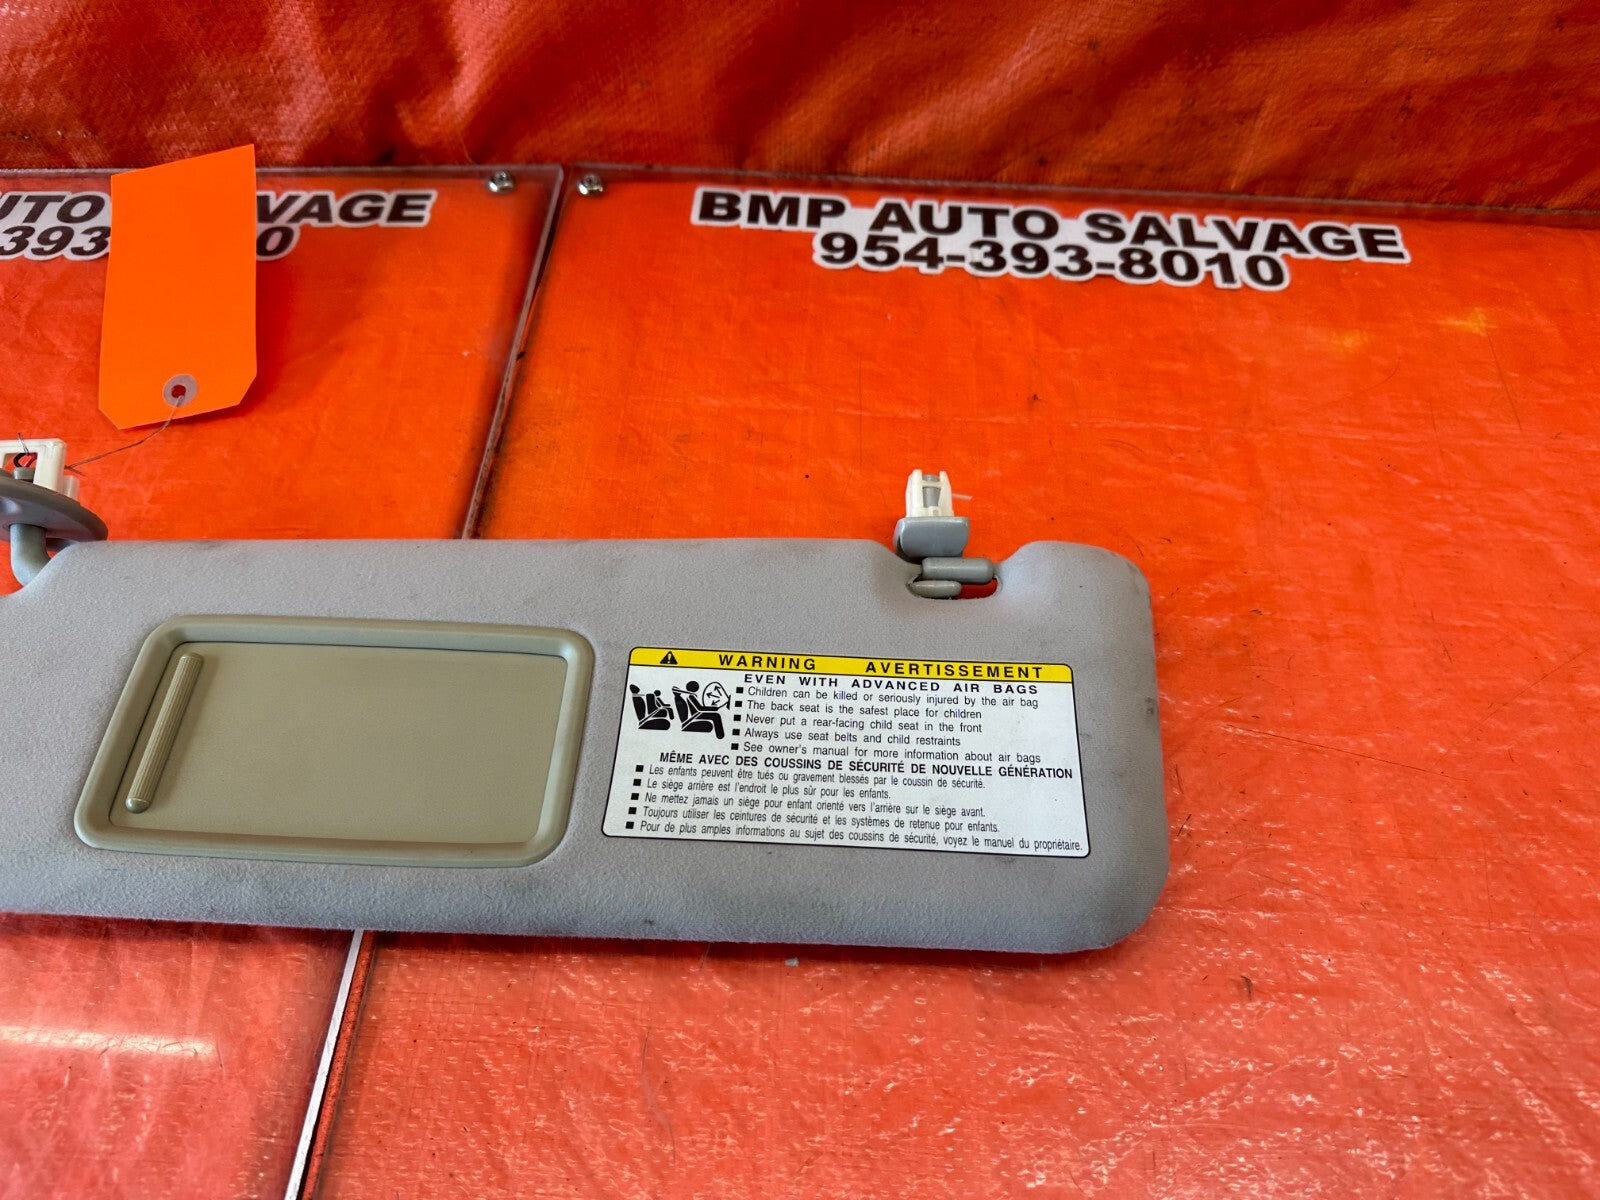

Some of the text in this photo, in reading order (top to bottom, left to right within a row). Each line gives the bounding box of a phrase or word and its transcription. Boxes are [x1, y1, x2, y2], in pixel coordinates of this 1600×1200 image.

[699, 191, 1406, 260] BMP AUTO SALVAGE
[820, 232, 1285, 287] 954-393-8010
[719, 654, 1043, 678] WARNING AVERTISSEMENT
[744, 674, 1038, 694] EVEN WITH ADVANCED AIR BAGS
[746, 700, 982, 719] The back seat is the safest place for children
[748, 686, 1038, 709] Children can be killed or seriously injured by the air bag
[746, 714, 982, 733] Never put a rear-facing child seat in the front
[744, 729, 961, 746] Always use seat belts and child restraints
[660, 750, 1072, 779] MÊME AVEC DES COUSSINS DE SÉCURITÉ DE NOUVELLE GÉNÉRATION
[743, 742, 1041, 765] See owner's manual for more information about air bags
[647, 778, 890, 799] Le siège arrière est l'endroit le plus sûr pour les enfants.
[649, 764, 986, 789] Les enfants peuvent être tués ou gravement blessés par le coussin de sécurité.
[644, 792, 985, 818] Ne mettez jamais un siège pour enfant orienté vers l'arrière sur le siège avant.
[643, 806, 1000, 833] Toujours utiliser les ceintures de sécurité et les systèmes de retenue pour enfants.
[640, 821, 1083, 851] Pour de plus amples informations au sujet des coussins de sécurité, voyez le manuel du propriétaire.
